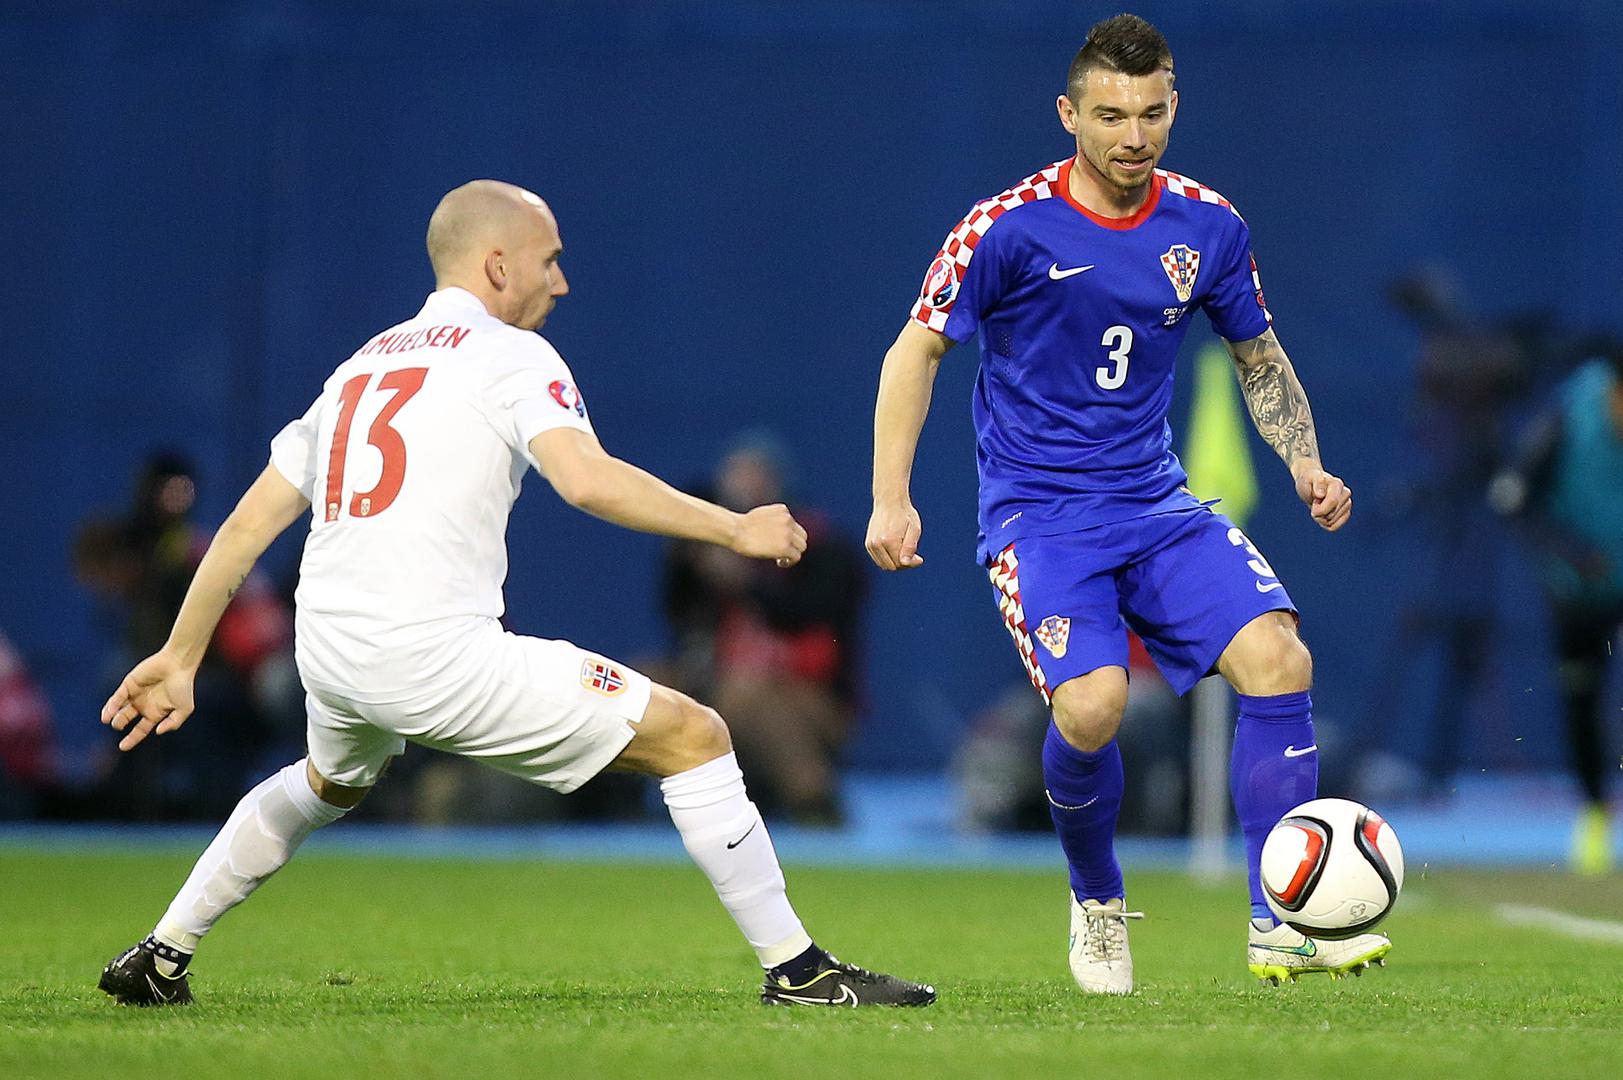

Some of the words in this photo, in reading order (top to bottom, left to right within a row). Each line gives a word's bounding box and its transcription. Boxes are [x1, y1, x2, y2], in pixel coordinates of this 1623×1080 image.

[1095, 325, 1134, 390] 3
[325, 366, 430, 523] 13
[1226, 527, 1276, 578] 3
